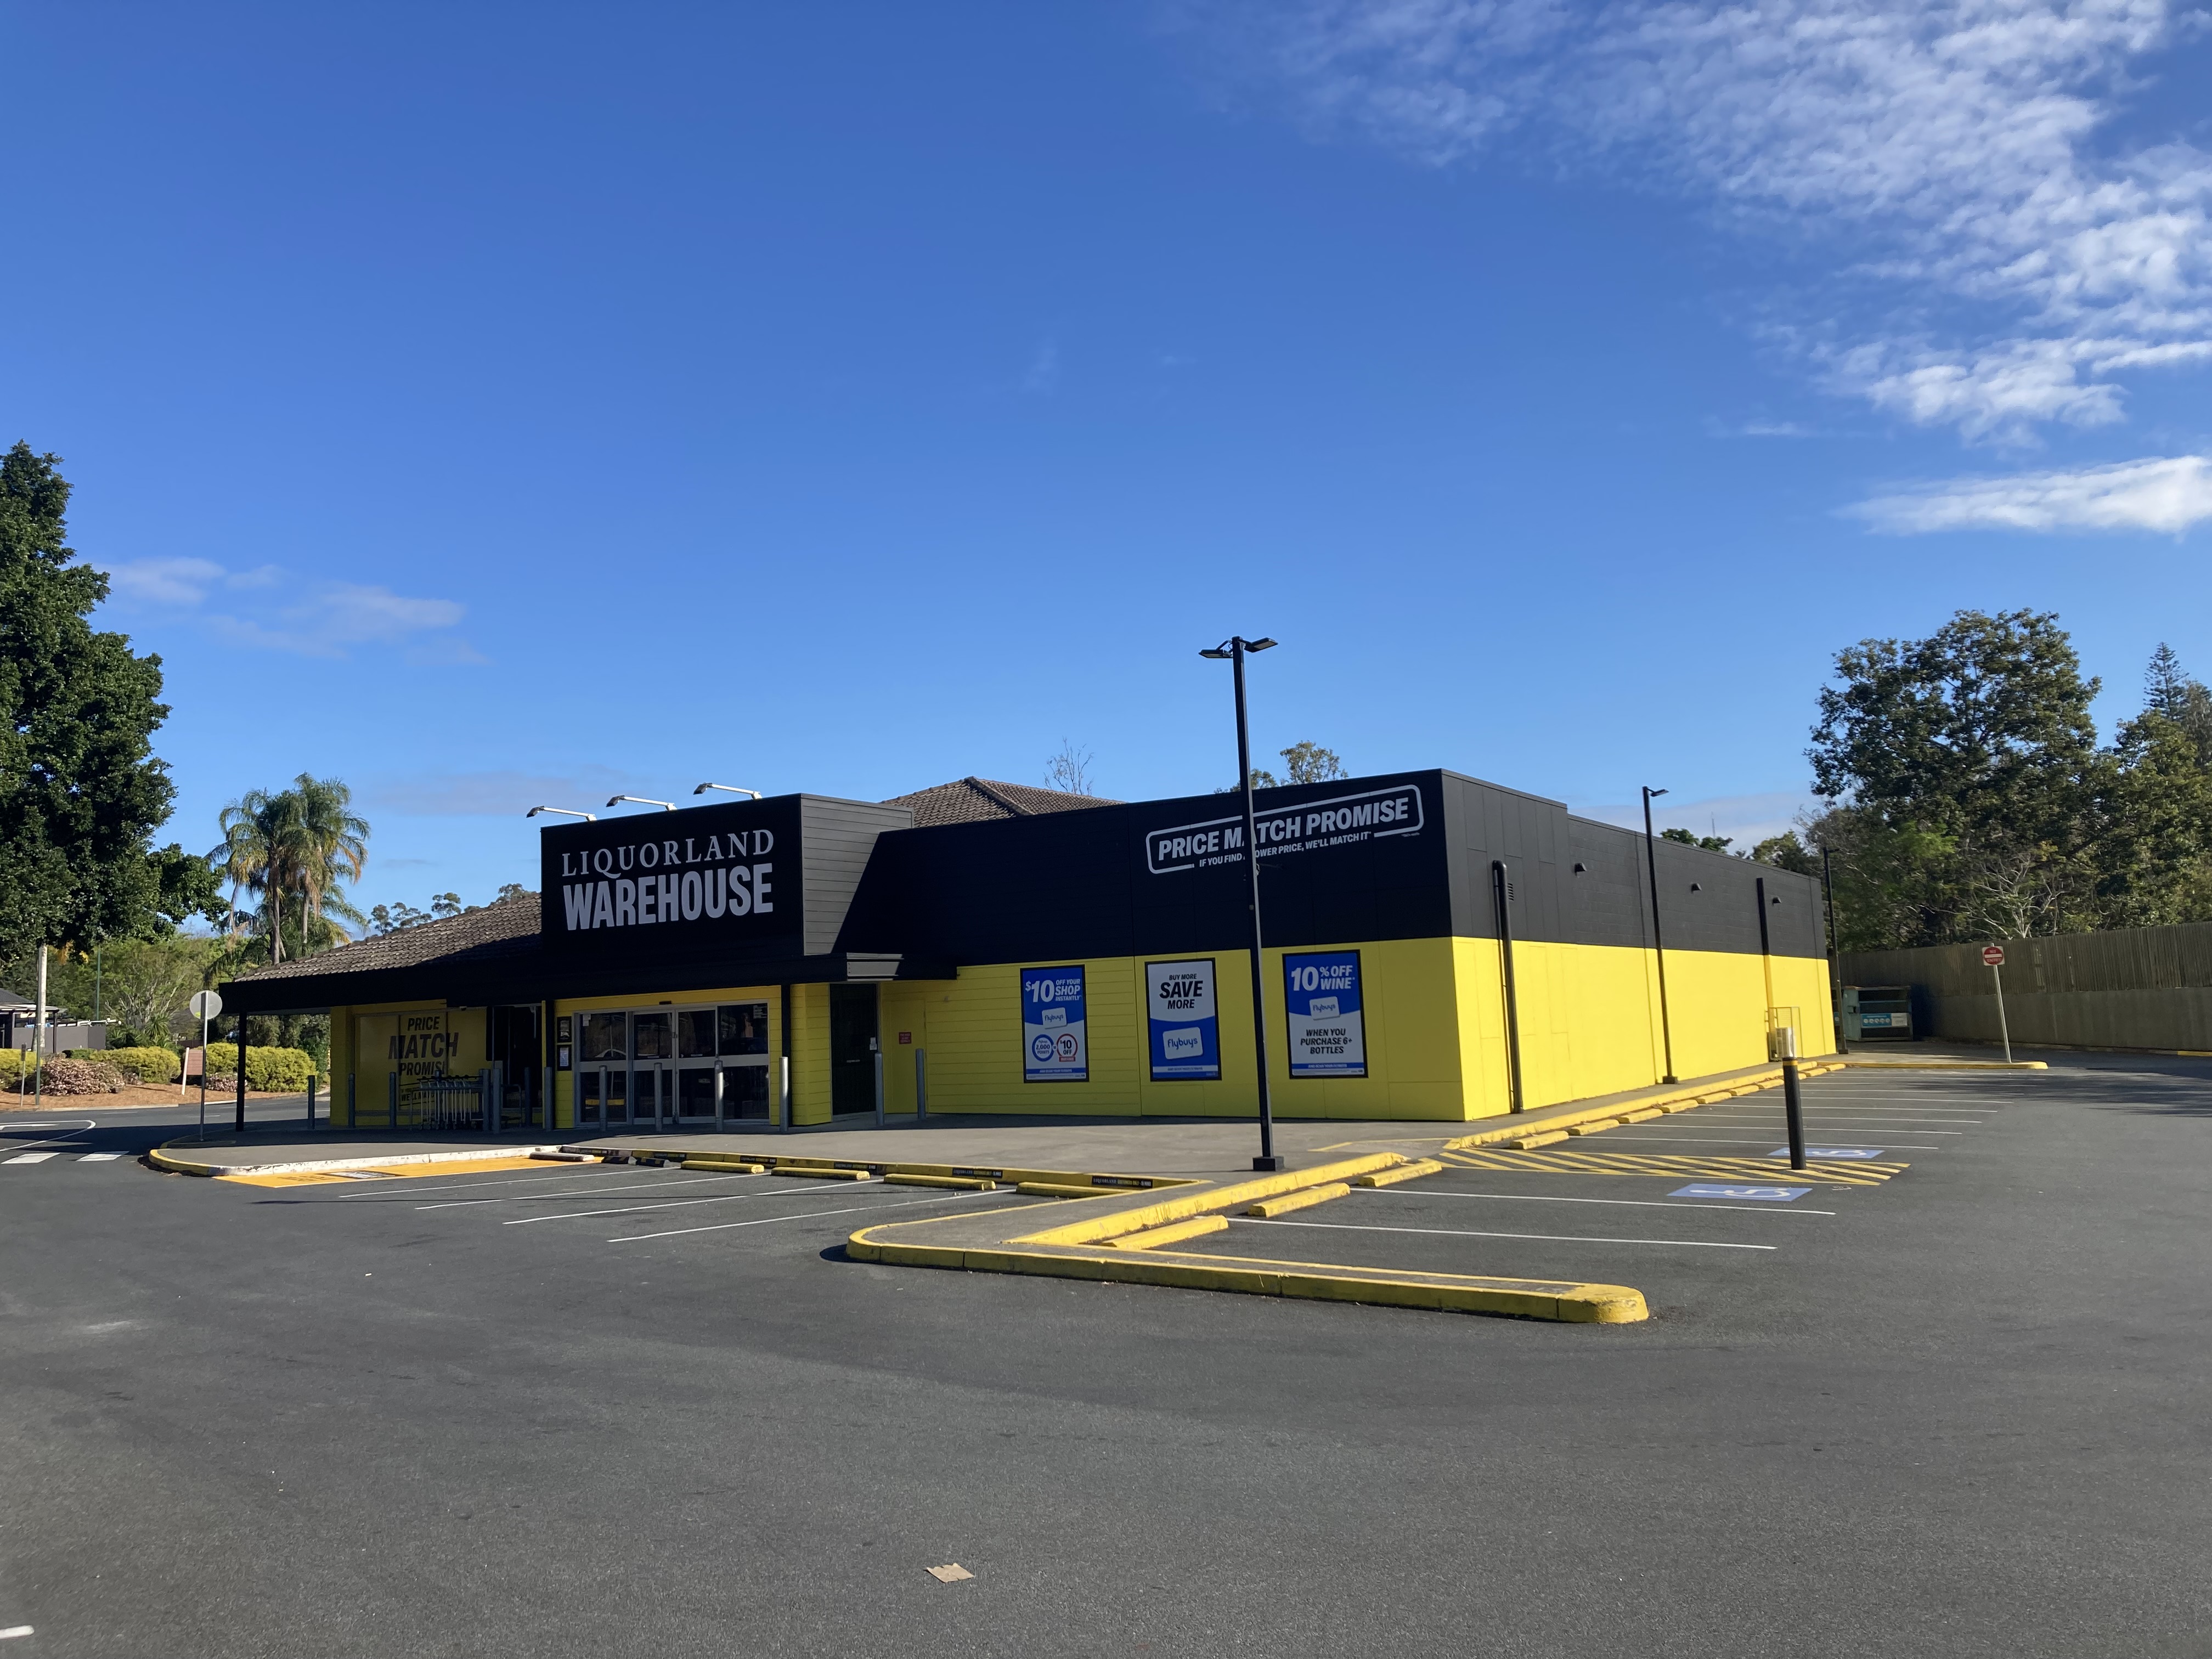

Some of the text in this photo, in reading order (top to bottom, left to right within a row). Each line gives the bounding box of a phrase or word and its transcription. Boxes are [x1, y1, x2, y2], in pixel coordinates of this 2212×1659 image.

[1159, 831, 1219, 861] PRICE
[1306, 797, 1409, 835] PROMISE
[562, 830, 774, 878] LIQUORLAND
[1199, 859, 1207, 867] IF
[1207, 856, 1223, 866] YOU
[1224, 853, 1243, 864] FIND
[1255, 847, 1277, 858] OWER
[1278, 843, 1304, 854] PRICE,
[1305, 839, 1329, 850] WE'LL
[1330, 833, 1359, 846] MATCH
[563, 864, 773, 930] WAREHOUSE
[1330, 965, 1353, 977] OFF
[1025, 980, 1054, 1003] $10
[1055, 985, 1081, 996] SHOP
[1159, 980, 1203, 998] SAVE
[1167, 999, 1195, 1009] MORE
[1313, 1003, 1336, 1013] flybuys
[407, 1016, 441, 1031] PRICE
[1045, 1014, 1064, 1023] flybuys
[1306, 1028, 1346, 1037] WHEN YOU
[388, 1032, 459, 1059] MATCH
[1167, 1037, 1198, 1050] flybuys
[1300, 1037, 1341, 1046] PURCHASE
[1310, 1046, 1344, 1054] BOTTLES
